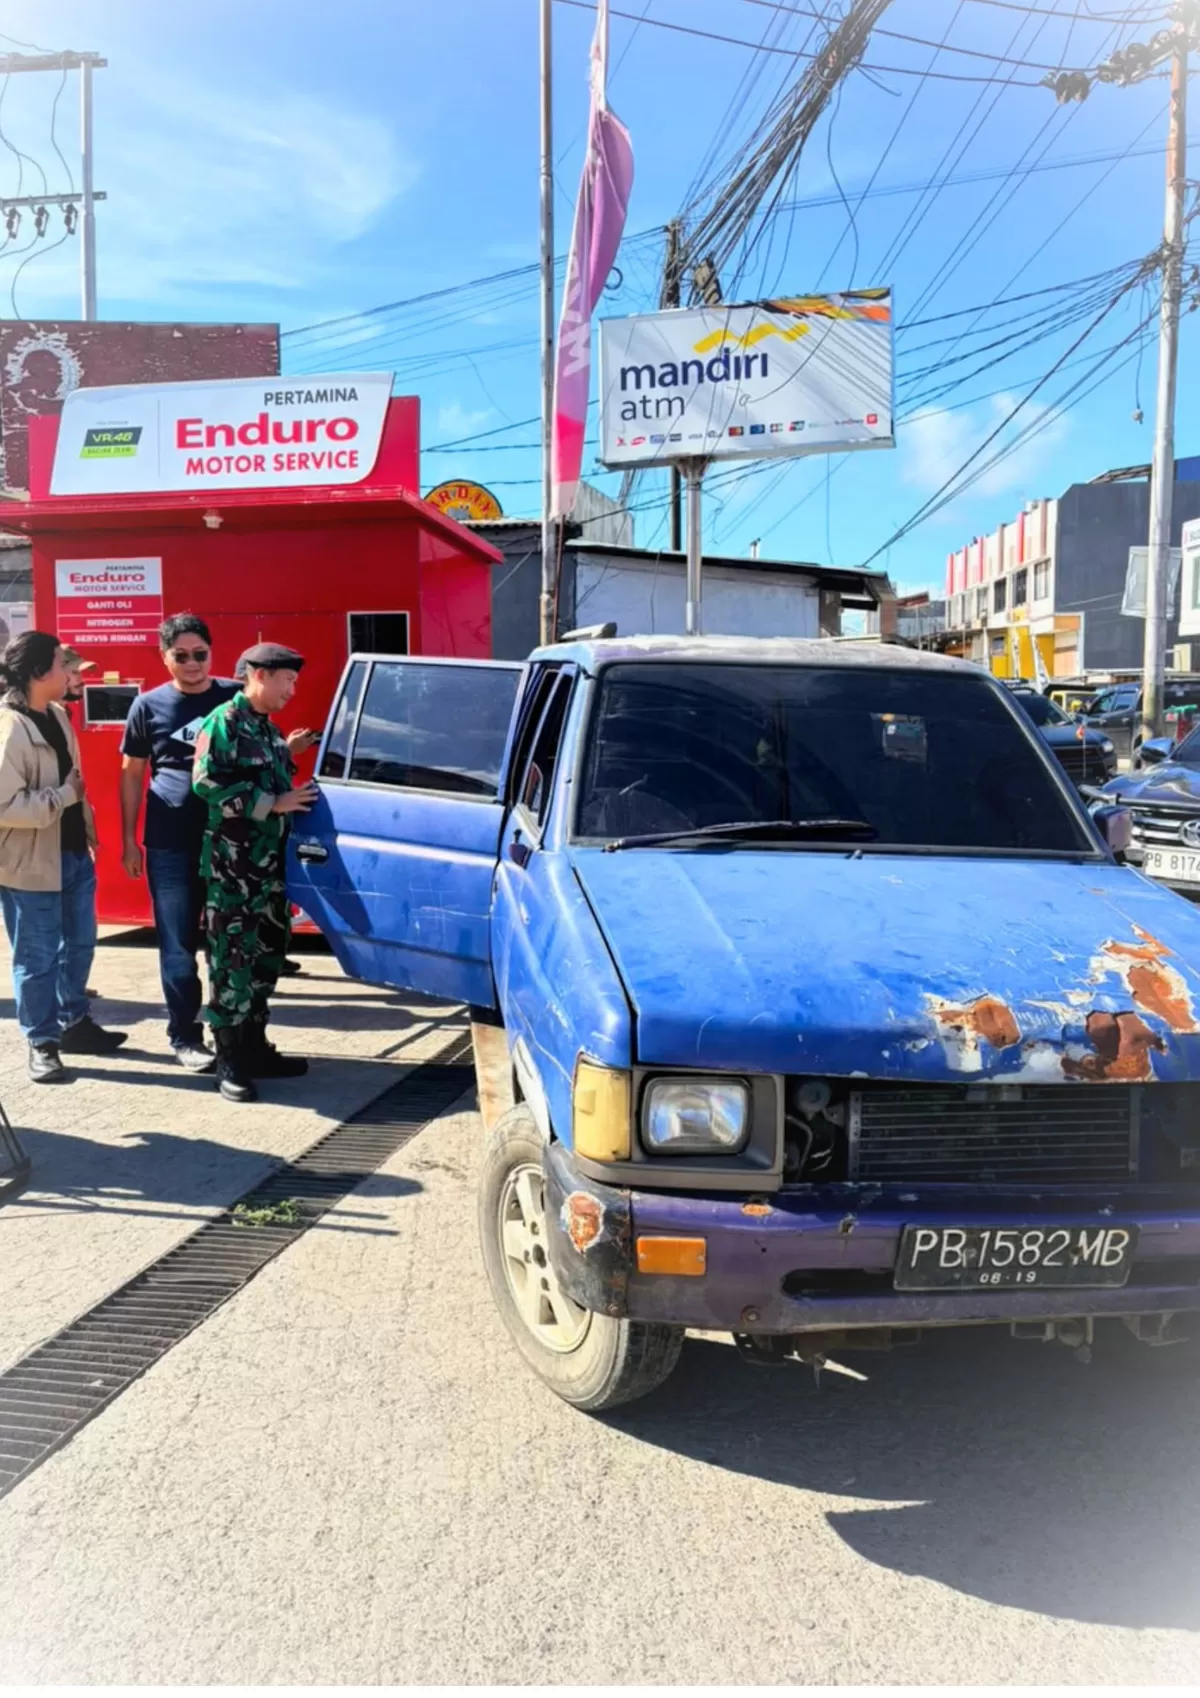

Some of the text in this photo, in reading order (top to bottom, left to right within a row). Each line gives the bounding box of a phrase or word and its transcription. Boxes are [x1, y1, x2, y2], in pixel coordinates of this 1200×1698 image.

[620, 347, 768, 391] mandiri
[264, 387, 359, 406] PERTAMINA
[620, 395, 685, 421] atm
[176, 412, 359, 449] Enduro
[185, 450, 359, 476] MOTOR SERVICE
[69, 572, 145, 584] Enduro
[74, 584, 146, 593] MOTOR SERVICE
[87, 601, 114, 609] GANTI
[87, 619, 134, 627] NITROGEN
[1143, 852, 1162, 868] PB
[911, 1229, 1129, 1268] PB 1582 MB
